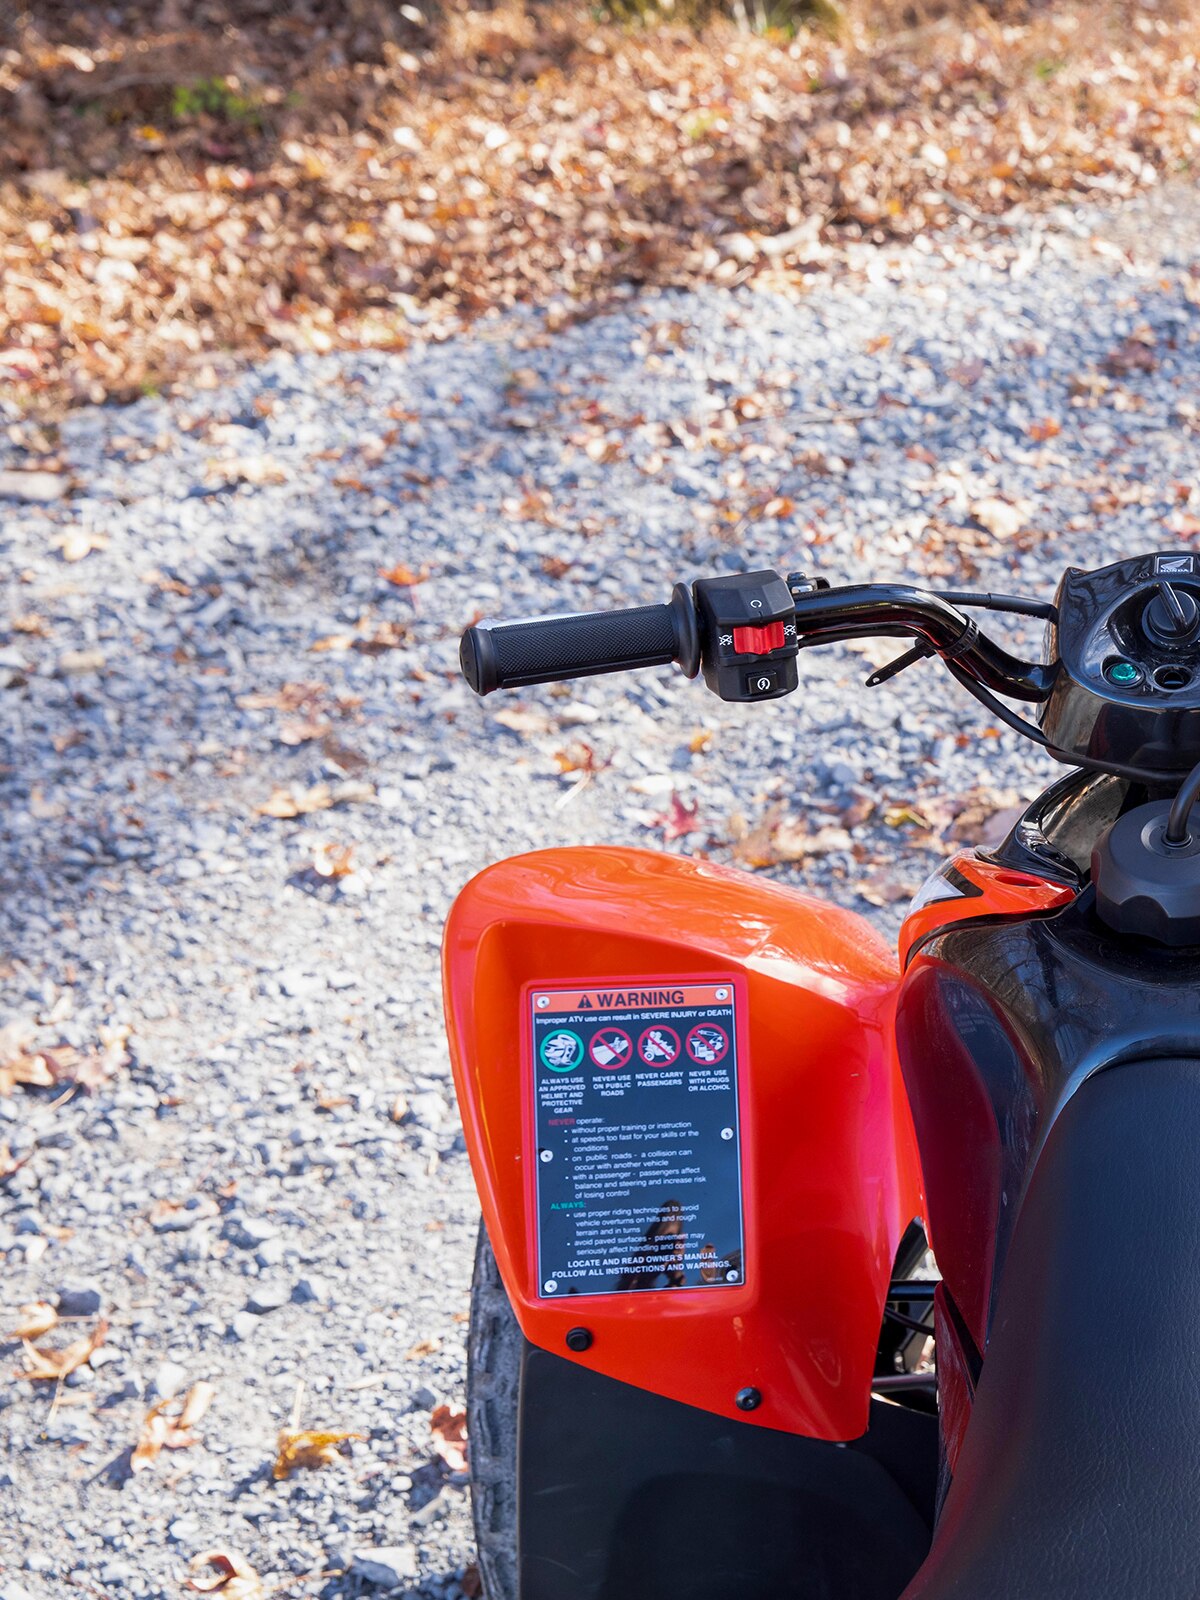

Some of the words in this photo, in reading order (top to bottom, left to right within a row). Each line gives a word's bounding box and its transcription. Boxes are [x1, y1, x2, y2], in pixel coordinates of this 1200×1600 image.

[597, 990, 684, 1007] WARNING
[536, 1016, 567, 1025] Improper
[569, 1015, 583, 1023] ATV
[640, 1012, 669, 1020] SEVERE
[548, 1118, 575, 1126] NEVER
[572, 1126, 596, 1134] without
[621, 1124, 647, 1132] training
[657, 1121, 691, 1129] instruction
[581, 1135, 605, 1143] speeds
[574, 1144, 608, 1152] conditions
[586, 1153, 608, 1161] public
[597, 1162, 611, 1170] with
[613, 1161, 641, 1169] another
[643, 1159, 669, 1167] vehicle
[595, 1171, 631, 1180] passenger
[639, 1168, 680, 1177] passengers
[681, 1166, 700, 1174] affect
[575, 1182, 602, 1190] balance
[619, 1179, 647, 1188] steering
[648, 1178, 661, 1186] and
[663, 1177, 692, 1185] increase
[694, 1175, 706, 1183] risk
[584, 1191, 604, 1199] losing
[606, 1189, 629, 1197] control
[551, 1202, 586, 1210] ALWAYS:
[588, 1210, 611, 1218] proper
[612, 1208, 631, 1216] riding
[633, 1206, 670, 1216] techniques
[575, 1219, 600, 1227] vehicle
[602, 1217, 634, 1225] overturns
[677, 1214, 697, 1222] rough
[594, 1237, 616, 1246] paved
[617, 1235, 646, 1243] surfaces
[655, 1232, 688, 1242] pavement
[690, 1232, 705, 1240] may
[576, 1248, 607, 1256] seriously
[609, 1245, 628, 1253] affect
[630, 1244, 659, 1252] handling
[675, 1241, 698, 1249] control
[567, 1259, 600, 1268] LOCATE
[602, 1258, 620, 1266] AND
[621, 1256, 644, 1265] READ
[646, 1254, 683, 1263] OWNER'S
[684, 1252, 718, 1260] MANUAL
[552, 1270, 586, 1278] FOLLOW
[606, 1264, 665, 1275] INSTRUCTIONS
[667, 1263, 684, 1271] AND
[686, 1261, 732, 1270] WARNINGS.
